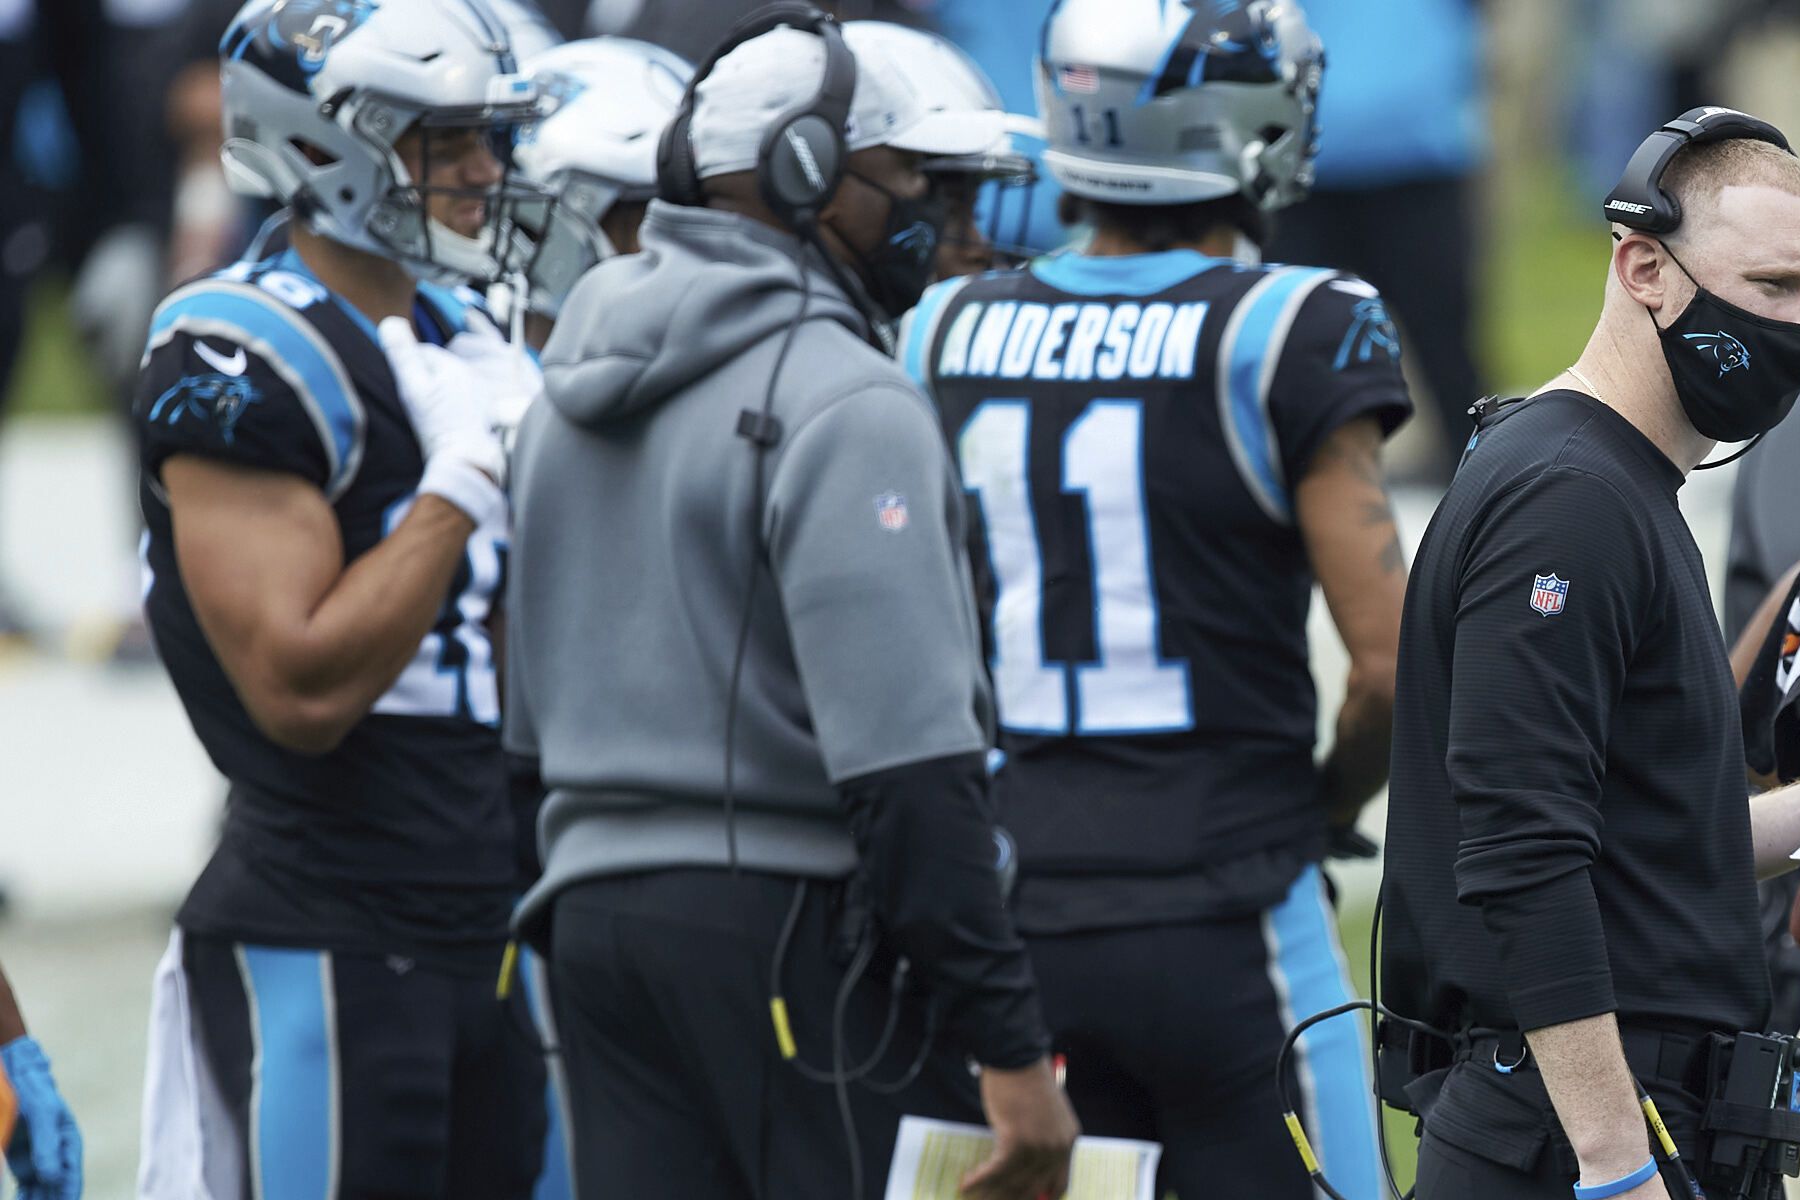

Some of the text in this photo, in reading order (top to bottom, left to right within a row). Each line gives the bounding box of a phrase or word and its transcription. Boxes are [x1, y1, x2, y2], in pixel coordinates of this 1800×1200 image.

[1070, 105, 1122, 145] 11
[1604, 199, 1653, 215] BOSE
[938, 301, 1210, 380] ANDERSON
[958, 397, 1196, 737] 11
[1534, 590, 1561, 610] NFL
